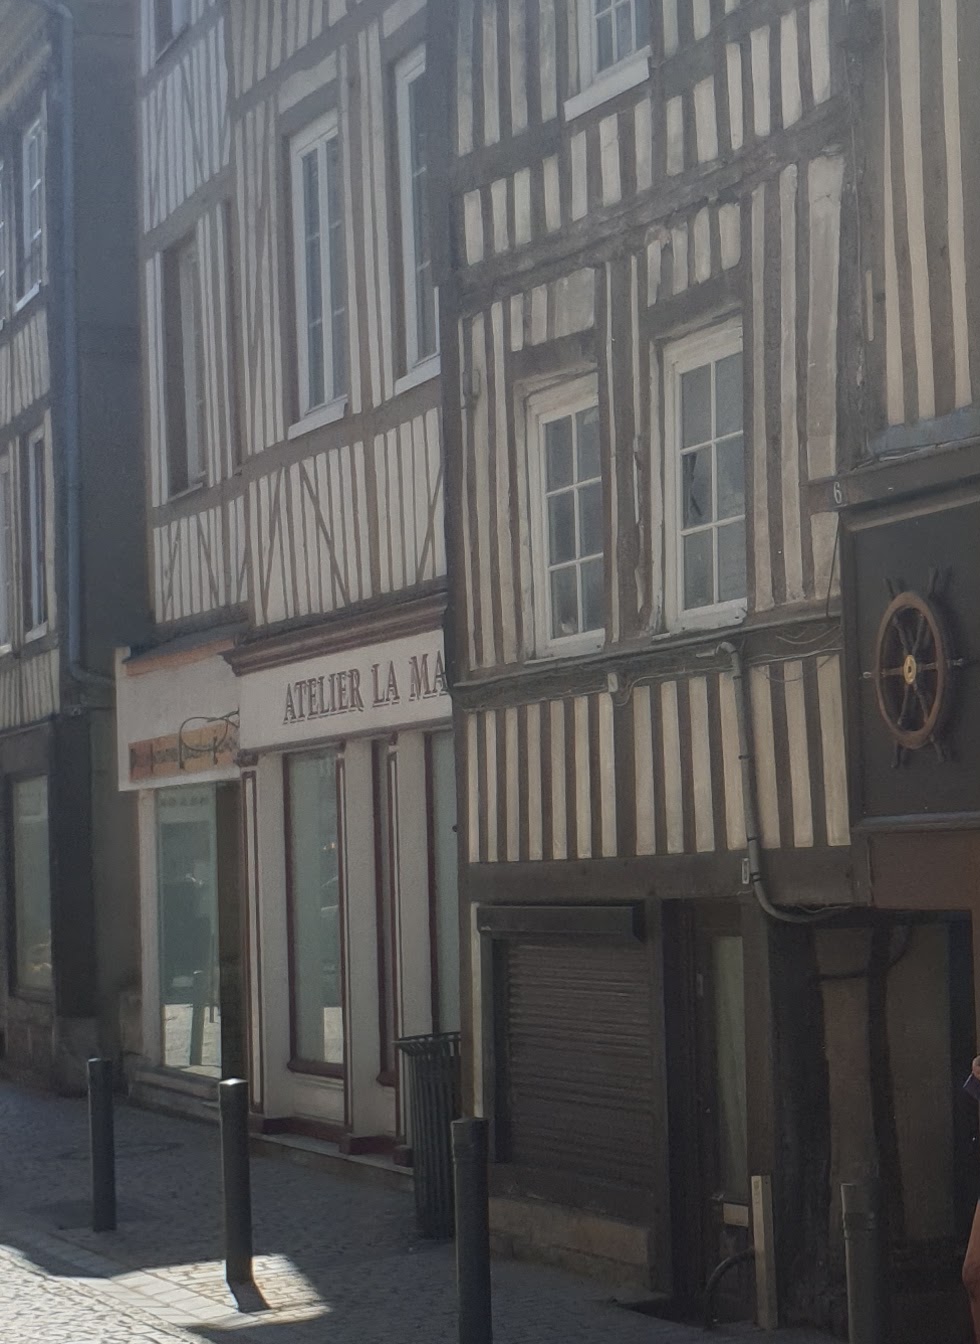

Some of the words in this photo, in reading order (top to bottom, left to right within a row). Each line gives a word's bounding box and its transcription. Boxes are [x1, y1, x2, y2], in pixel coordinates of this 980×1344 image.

[833, 481, 842, 504] 6
[283, 668, 364, 724] ATELIER
[371, 660, 401, 708] LA
